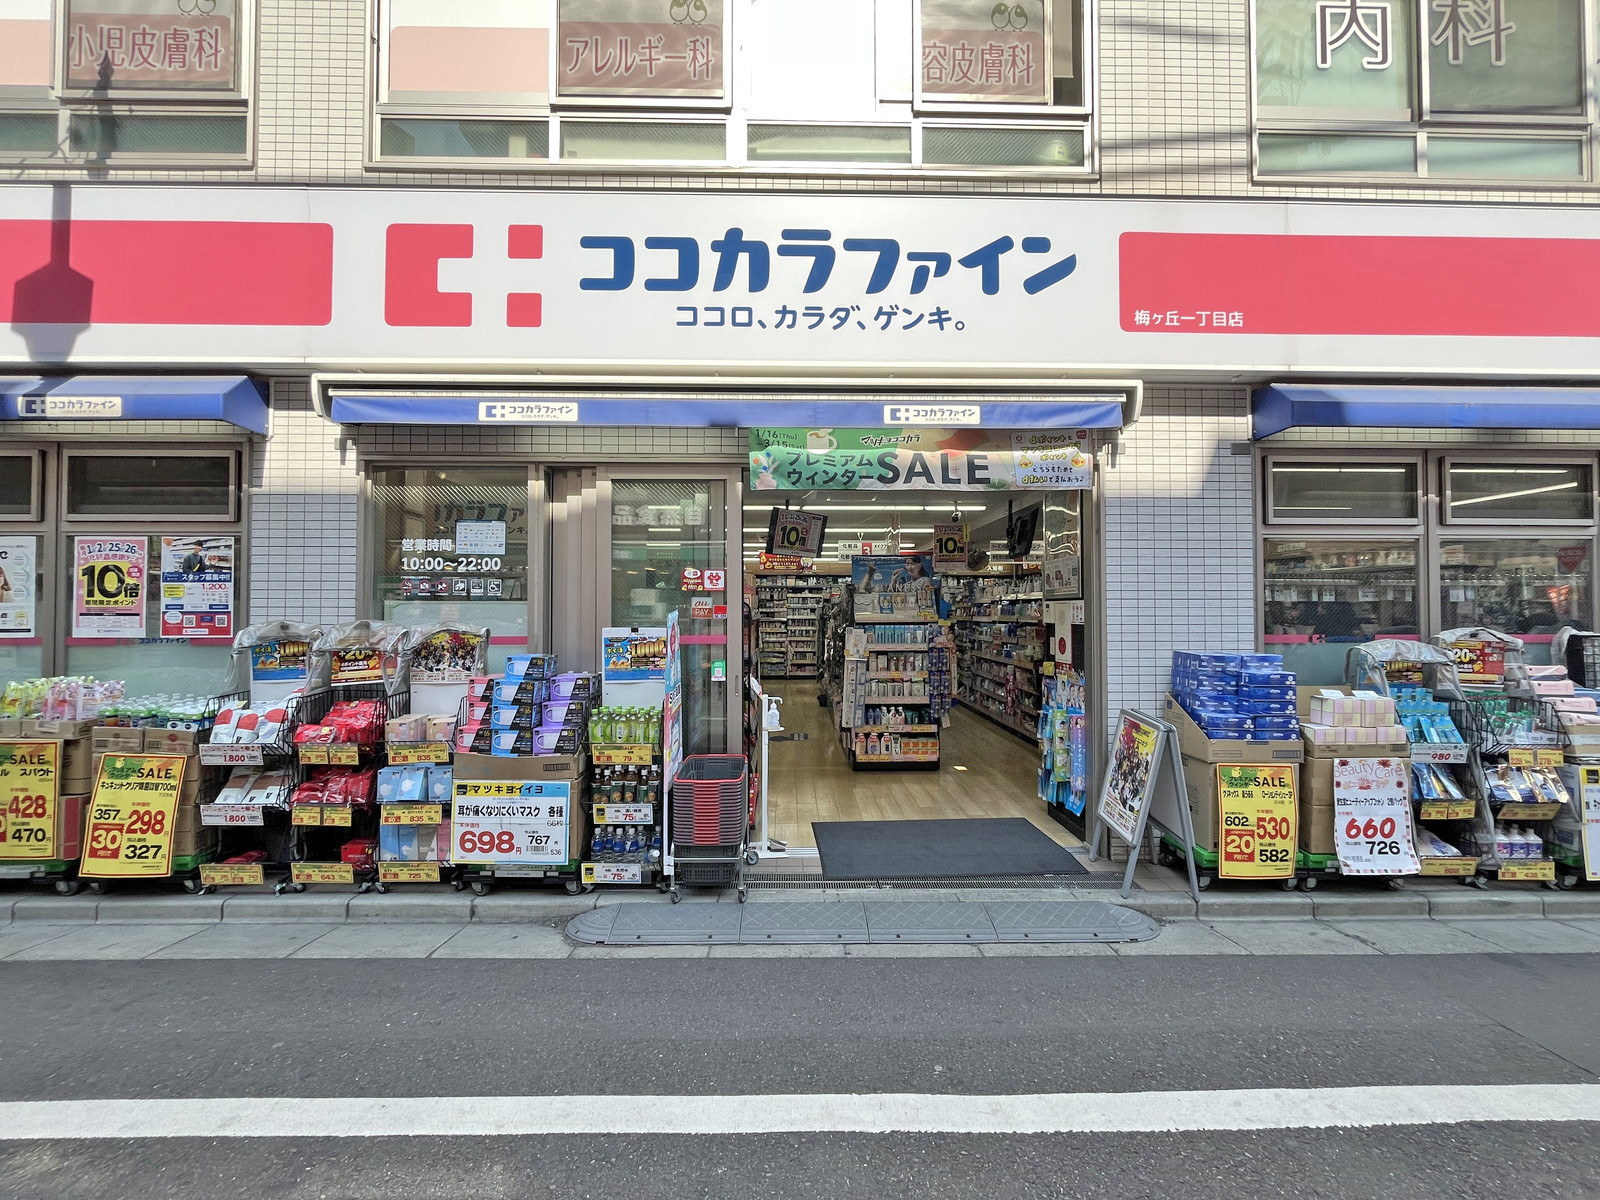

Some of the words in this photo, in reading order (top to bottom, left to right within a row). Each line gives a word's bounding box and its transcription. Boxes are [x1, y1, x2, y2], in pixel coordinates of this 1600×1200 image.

[69, 25, 224, 71] 小児皮膚科
[566, 34, 715, 80] アレルギー科
[579, 227, 1077, 296] ココカラファイン
[49, 401, 116, 409] ココカラファイン
[509, 405, 573, 414] ココカラファイン
[913, 408, 975, 417] ココカラファイン
[786, 451, 874, 468] プレミアム
[876, 451, 991, 485] SALE
[402, 538, 453, 551] 営業時間
[10, 754, 46, 765] SALE
[1375, 767, 1404, 779] Care
[1253, 776, 1286, 787] SALE
[94, 809, 121, 820] 357
[458, 805, 540, 817] 耳が痛くなりにくいマスク
[548, 806, 564, 818] 各種
[1225, 816, 1249, 827] 602
[1345, 817, 1396, 839] 660
[92, 829, 122, 849] 30
[1226, 835, 1254, 854] 20
[1365, 841, 1401, 855] 726
[1259, 849, 1290, 862] 582
